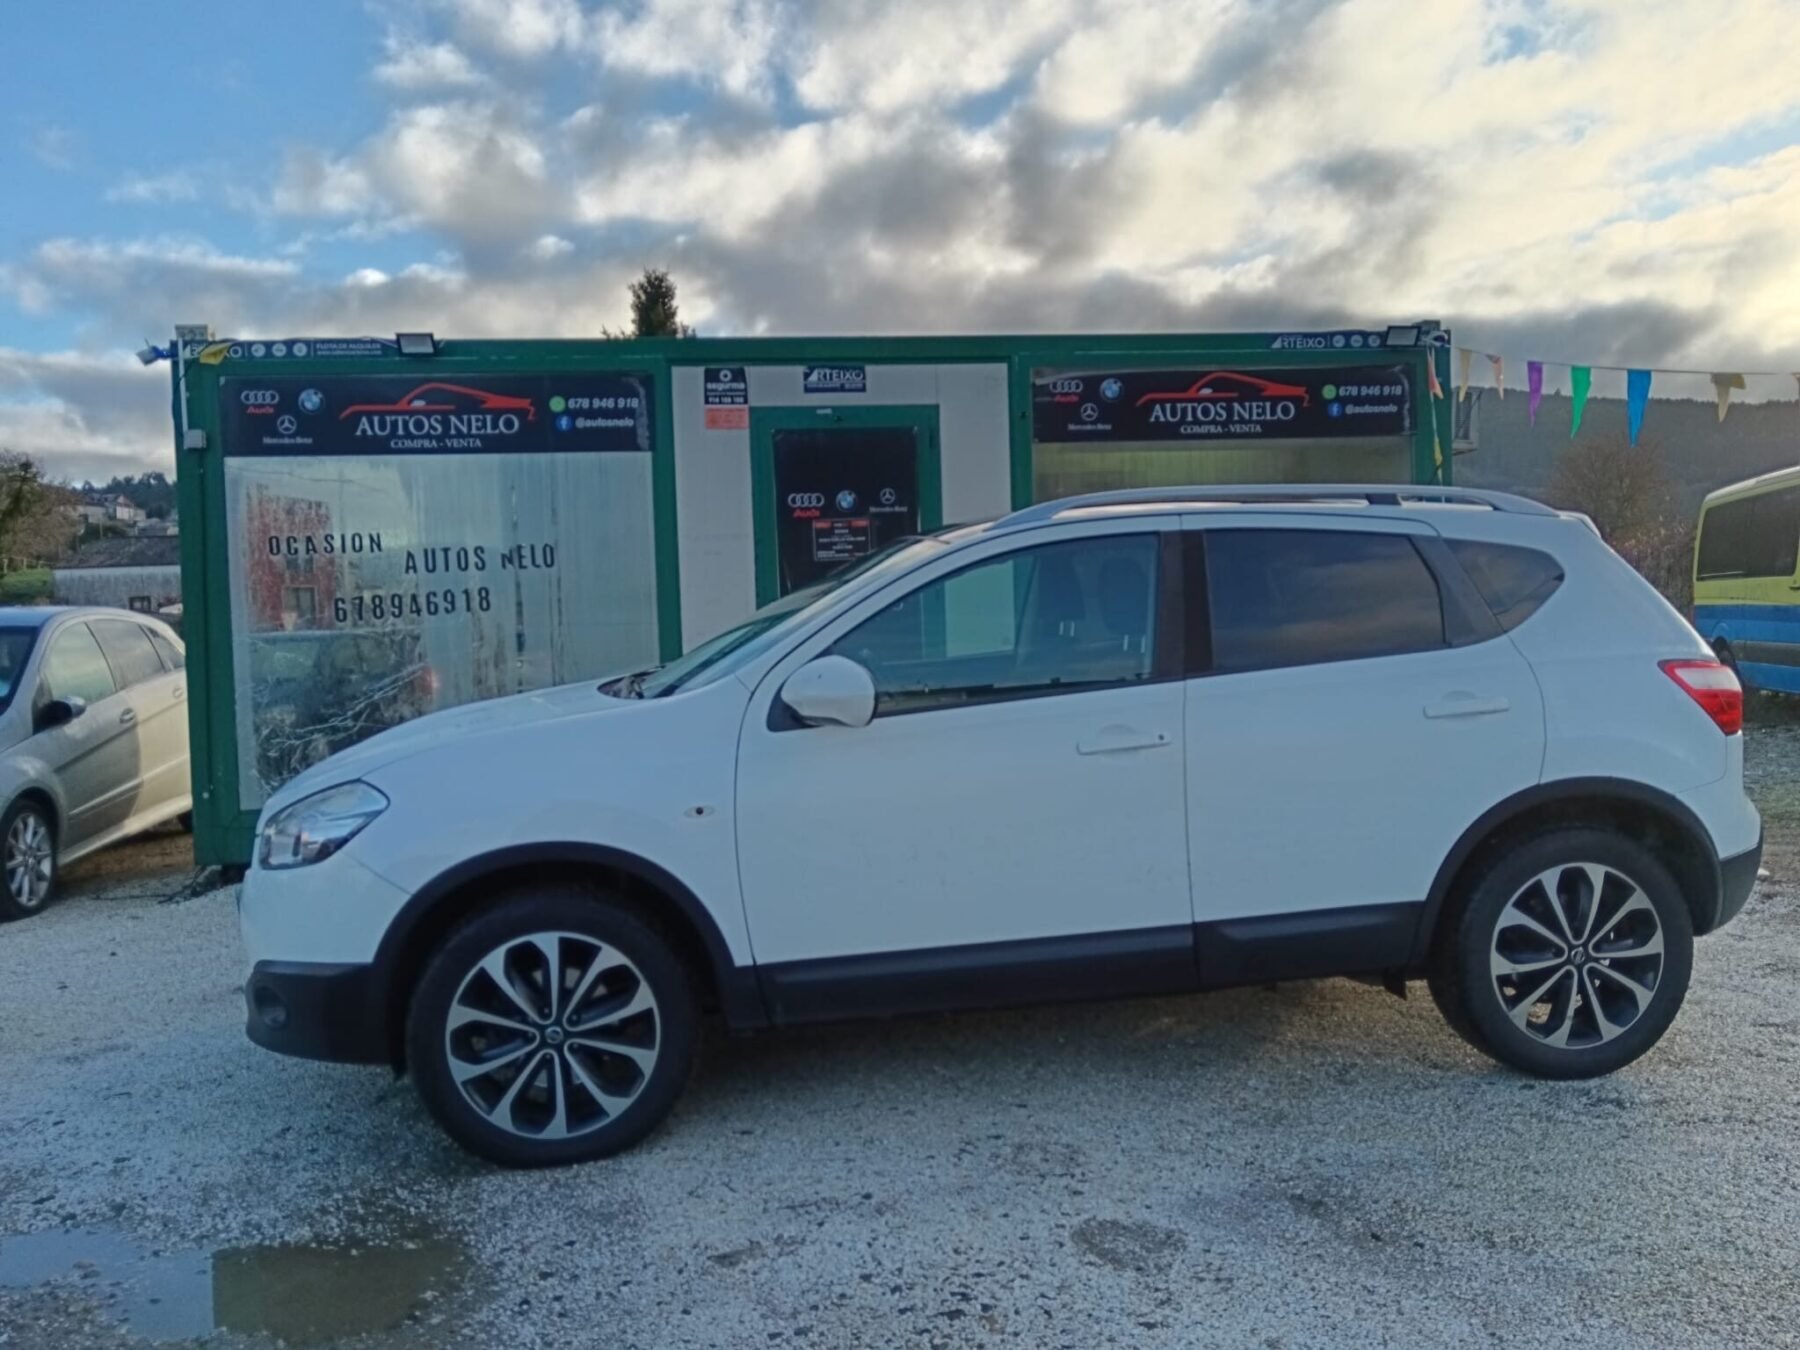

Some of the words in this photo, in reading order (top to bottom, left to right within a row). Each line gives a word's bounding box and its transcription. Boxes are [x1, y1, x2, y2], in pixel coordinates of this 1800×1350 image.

[1271, 335, 1326, 349] ARTEIXO
[808, 368, 864, 381] ARTEIXO
[1339, 385, 1358, 397] 678
[1360, 385, 1381, 396] 946
[1383, 384, 1402, 396] 918
[567, 397, 590, 409] 678
[592, 397, 615, 409] 946
[617, 397, 639, 409] 918
[1345, 403, 1398, 415] @autosnelo
[1149, 401, 1227, 422] AUTOS
[1233, 400, 1296, 420] NELO
[355, 414, 443, 436] AUTOS
[449, 413, 520, 435] NELO
[575, 416, 635, 429] @autosnelo
[1180, 424, 1223, 434] COMPRA
[1229, 424, 1262, 433] VENTA
[390, 438, 438, 449] COMPRA
[445, 437, 482, 448] VENTA
[268, 532, 383, 556] OCASION
[405, 545, 487, 575] AUTOS
[501, 543, 556, 571] NELO
[334, 586, 491, 623] 678946918
